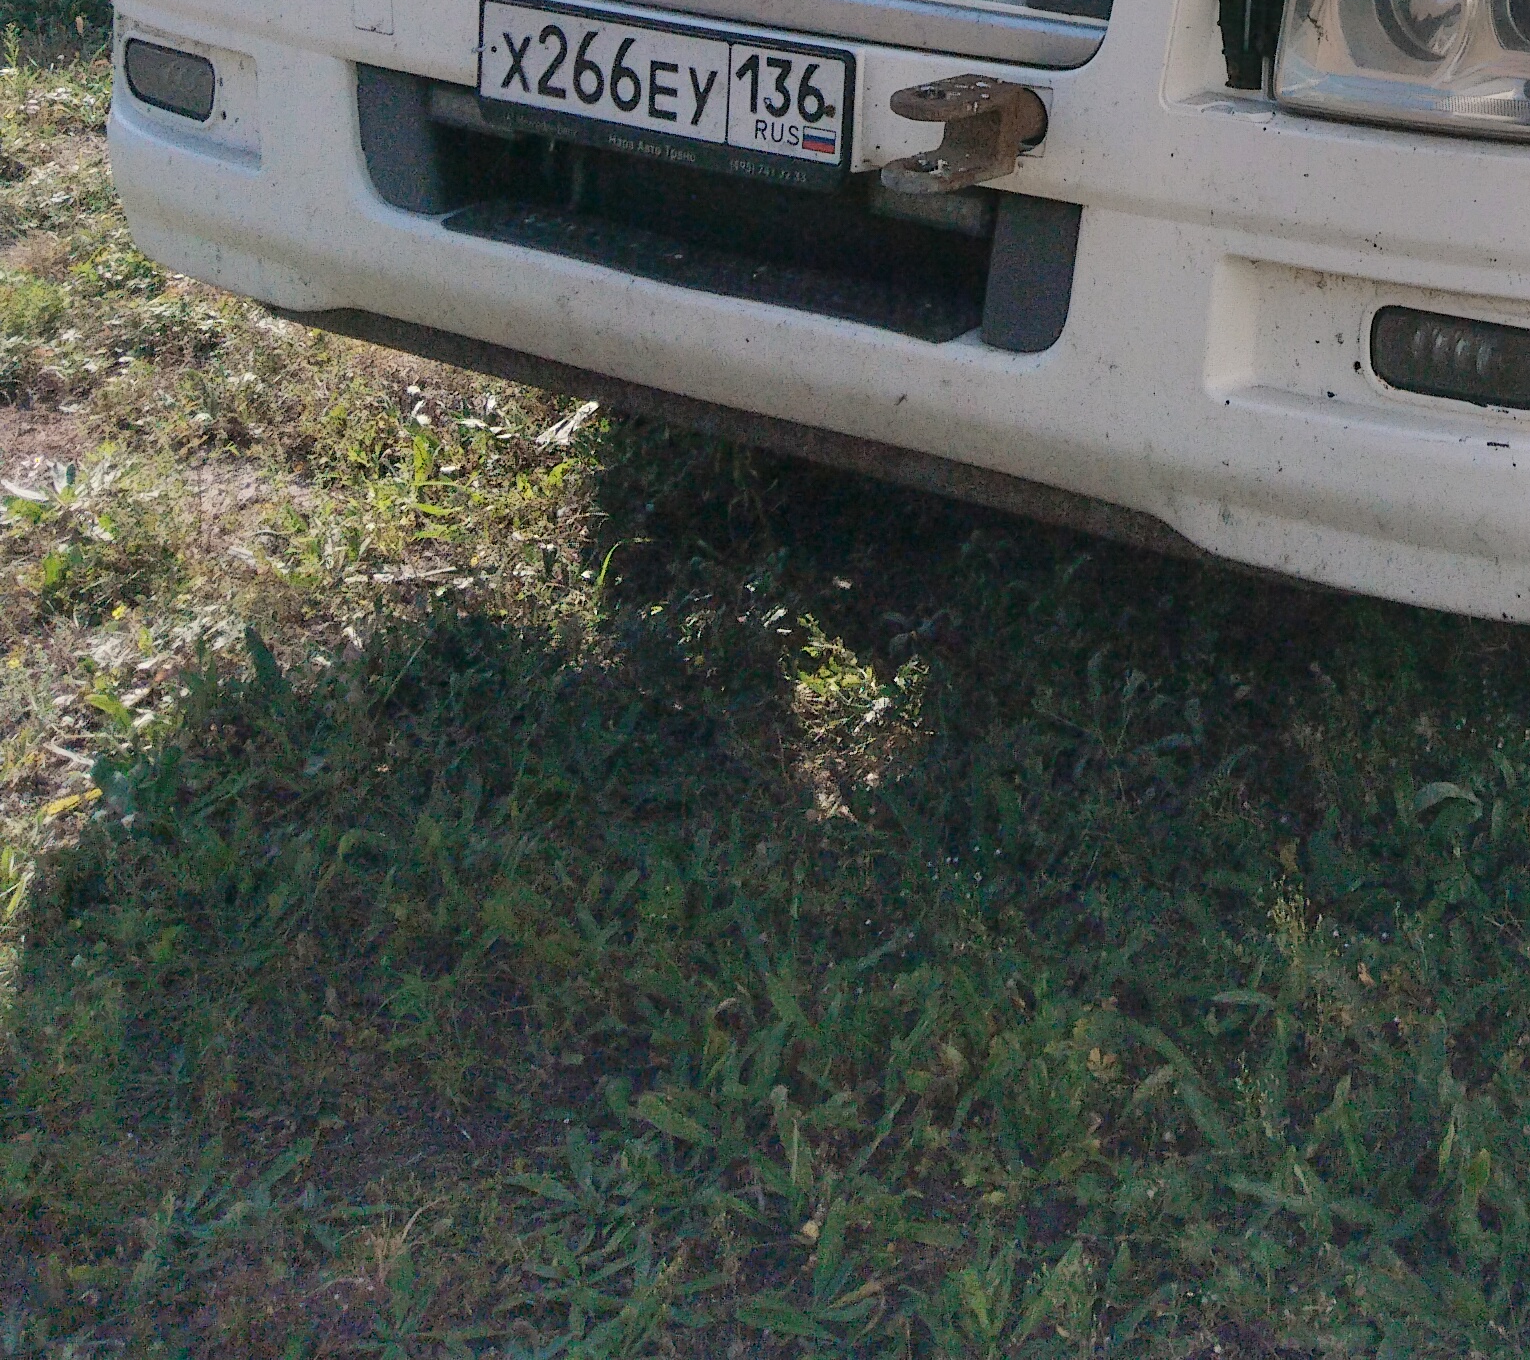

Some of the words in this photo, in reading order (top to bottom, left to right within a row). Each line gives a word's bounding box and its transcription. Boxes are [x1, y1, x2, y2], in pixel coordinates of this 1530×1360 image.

[500, 24, 719, 126] Х266ЕУ
[735, 53, 826, 124] 136
[754, 118, 800, 146] RUS
